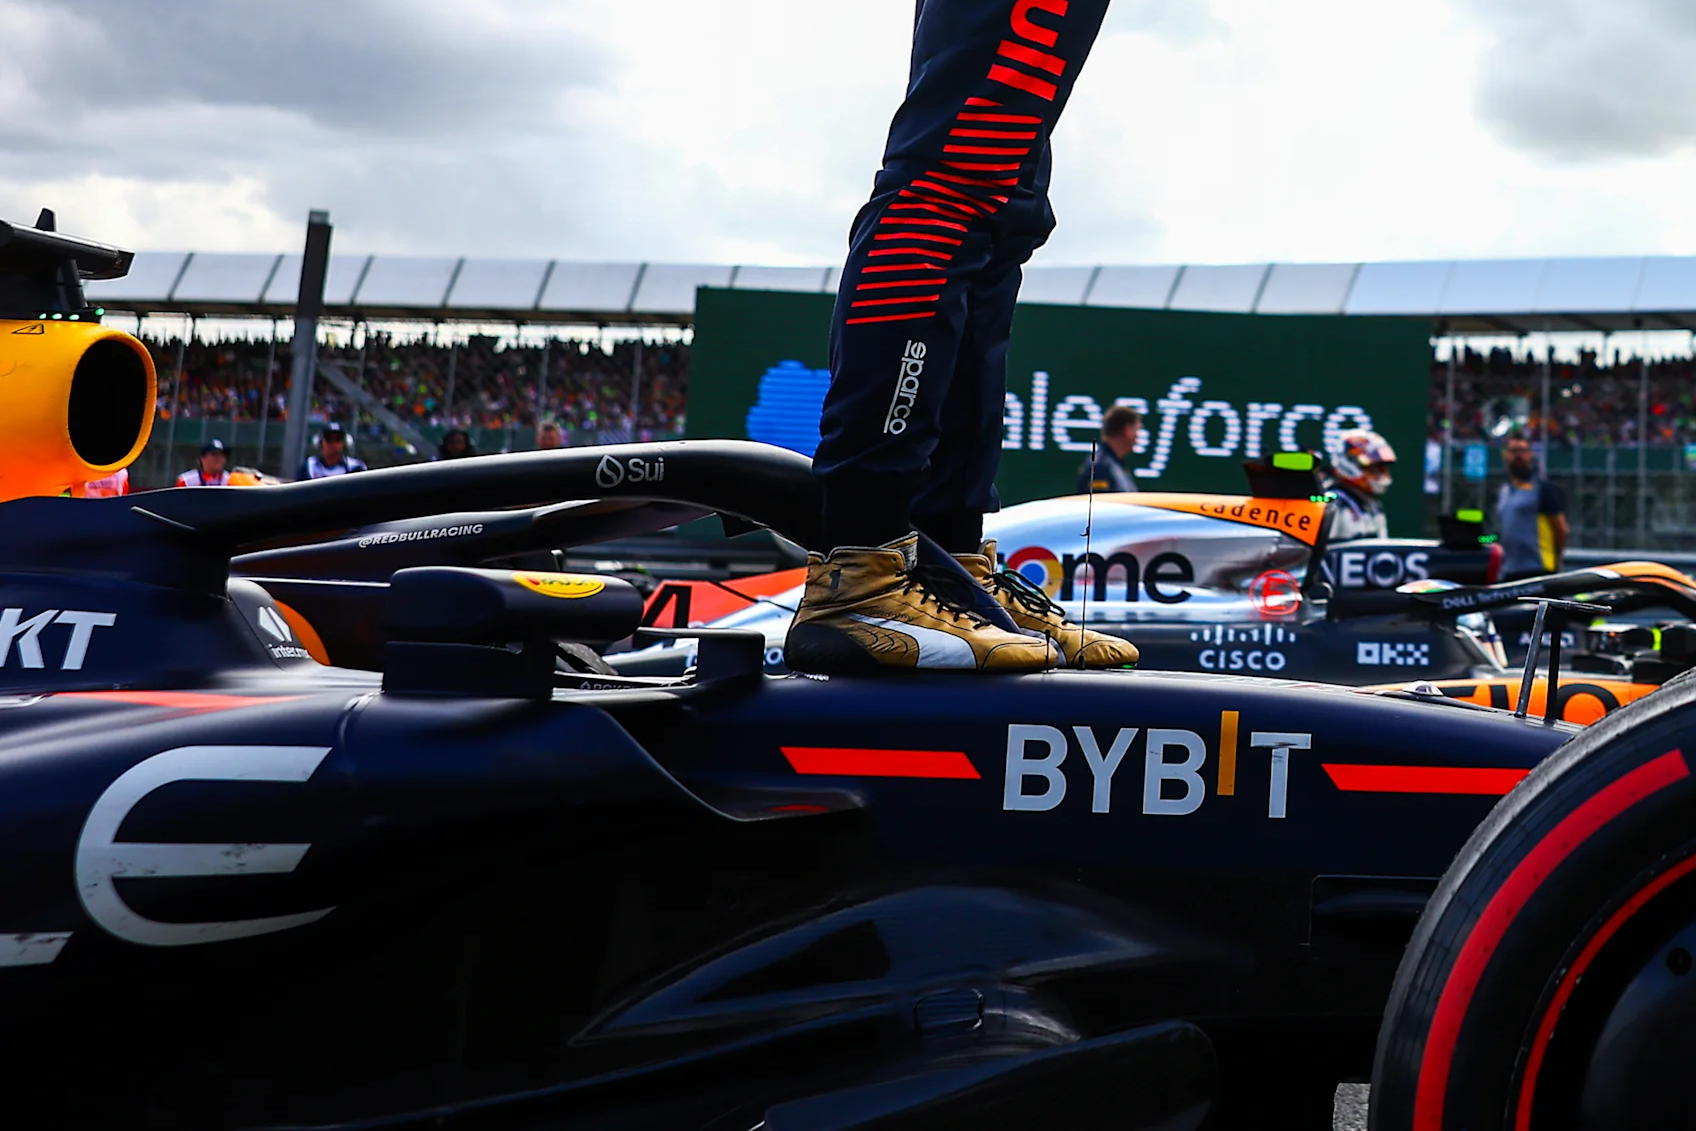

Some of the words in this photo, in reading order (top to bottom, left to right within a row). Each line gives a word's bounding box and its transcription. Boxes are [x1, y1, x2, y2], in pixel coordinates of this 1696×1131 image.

[628, 456, 665, 482] Sui
[1200, 501, 1312, 532] cadence
[358, 523, 484, 549] @REDBULLRACING
[1321, 551, 1431, 588] NEOS
[1199, 649, 1286, 670] CISCO
[1356, 642, 1430, 666] OKX
[1002, 710, 1312, 819] BYBIT
